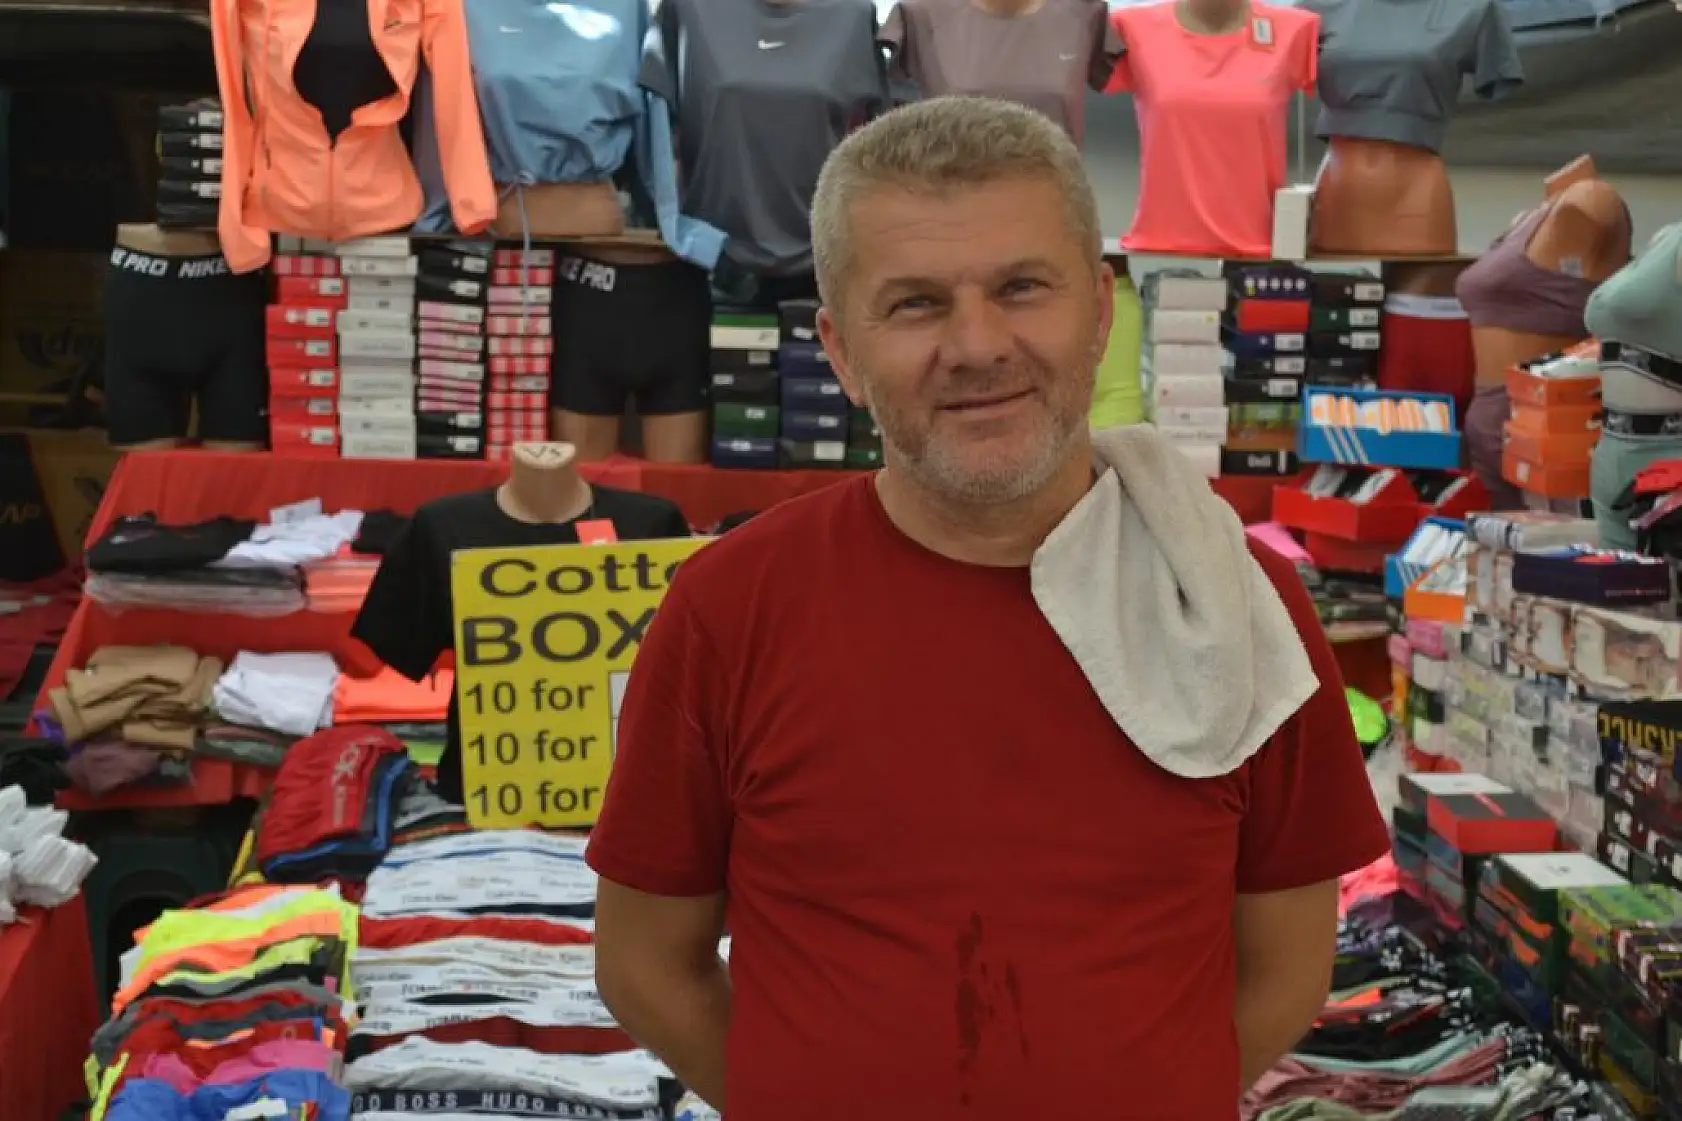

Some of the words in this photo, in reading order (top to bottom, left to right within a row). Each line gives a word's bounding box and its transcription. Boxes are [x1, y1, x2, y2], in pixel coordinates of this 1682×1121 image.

[123, 253, 168, 277] PRO
[580, 262, 615, 292] PRO
[465, 681, 516, 715] 10
[530, 677, 595, 712] for
[468, 732, 520, 765] 10
[533, 729, 598, 763] for
[471, 783, 522, 817] 10
[536, 780, 600, 814] for
